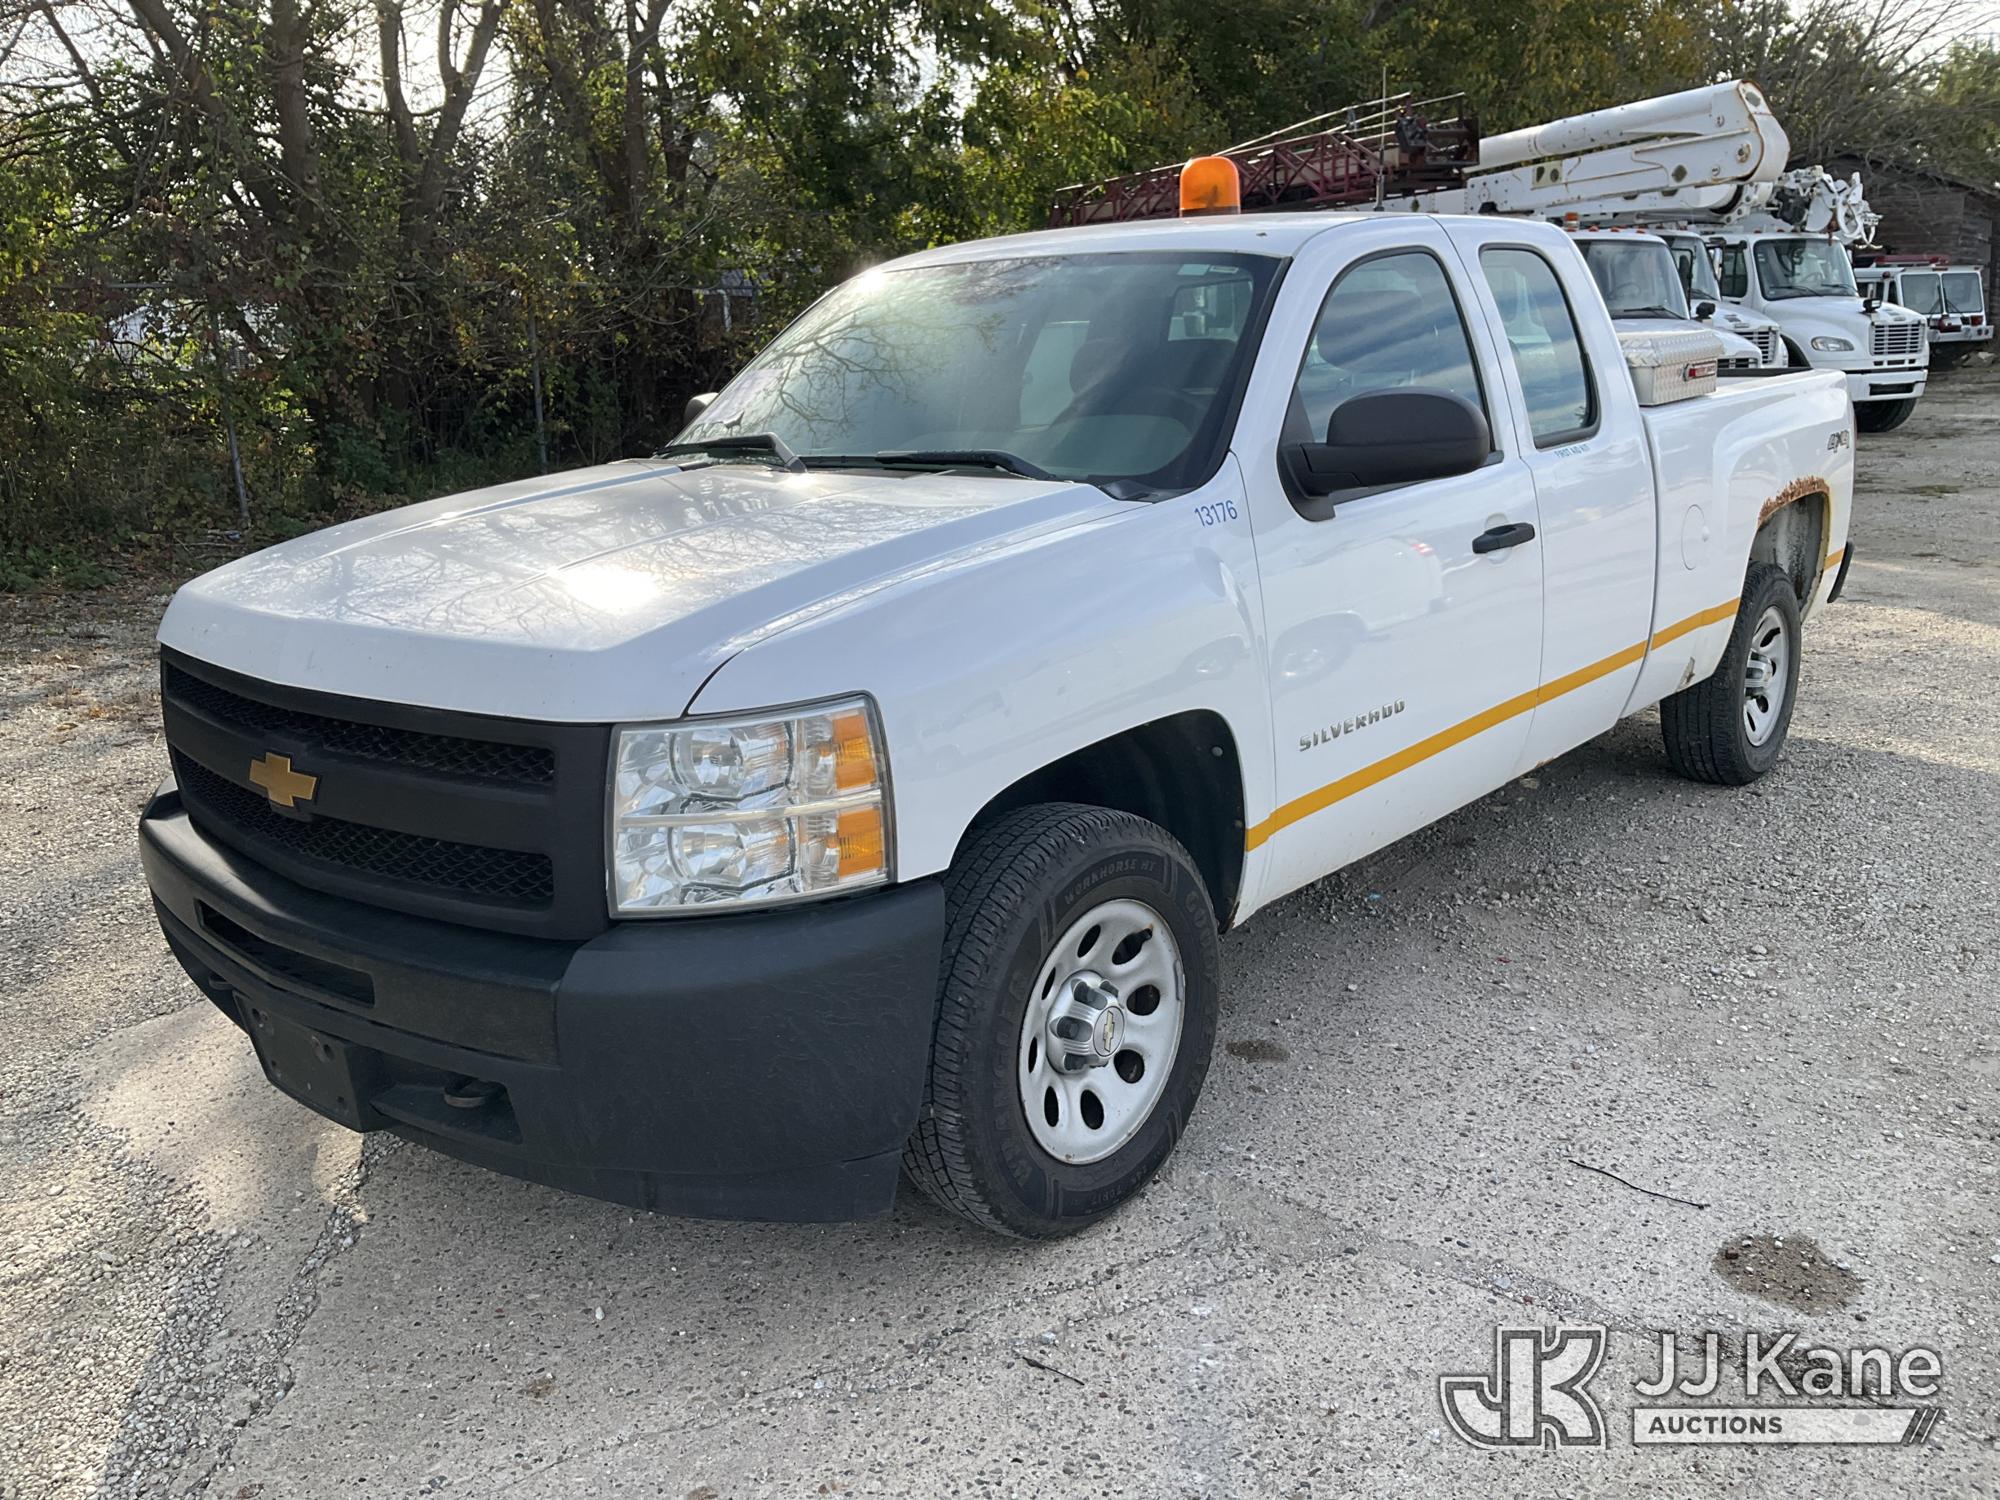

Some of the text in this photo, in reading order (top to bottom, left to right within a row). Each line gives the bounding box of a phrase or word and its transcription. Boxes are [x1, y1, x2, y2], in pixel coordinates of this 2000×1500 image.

[1194, 499, 1238, 527] 13176
[1299, 698, 1406, 752] SILVERADO
[1065, 859, 1138, 905] WORKHORSE
